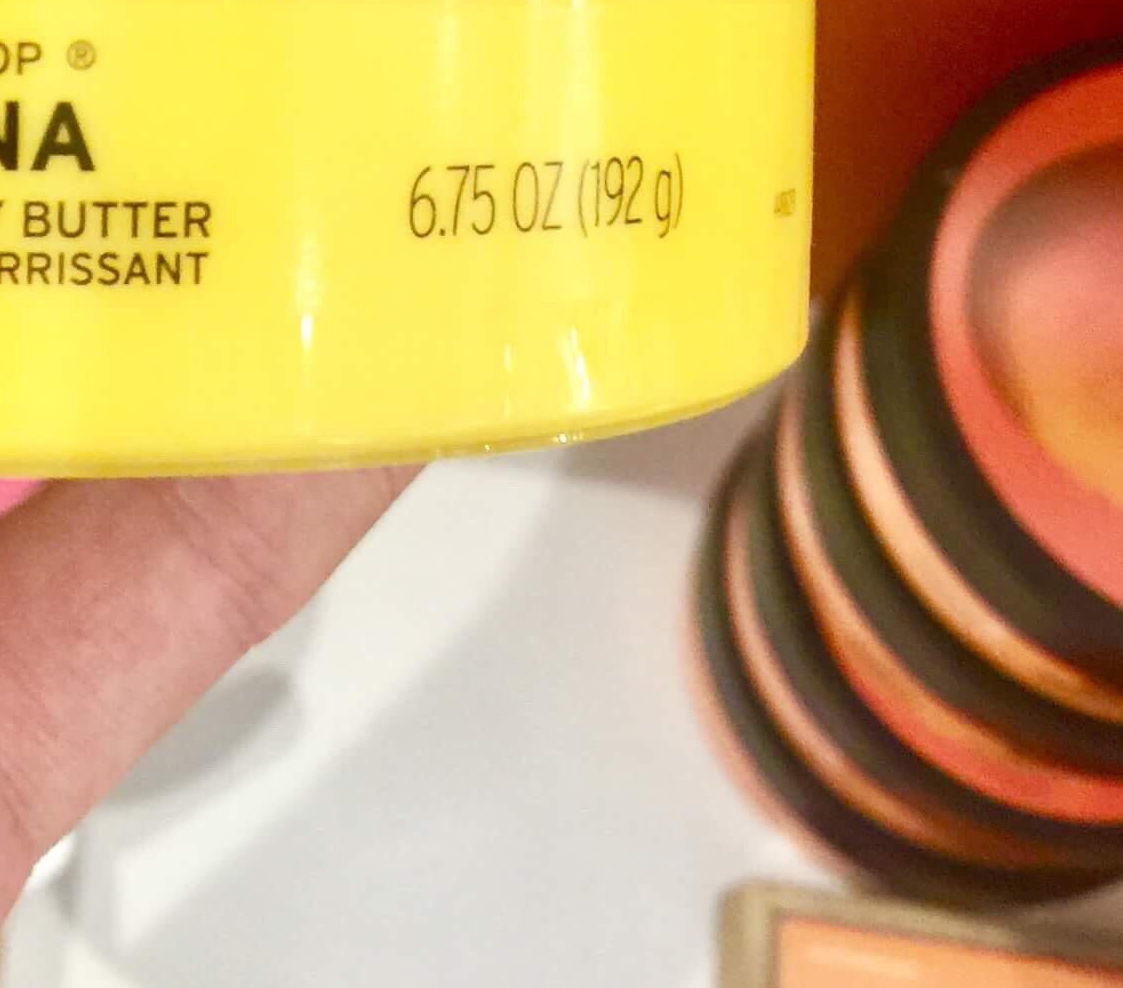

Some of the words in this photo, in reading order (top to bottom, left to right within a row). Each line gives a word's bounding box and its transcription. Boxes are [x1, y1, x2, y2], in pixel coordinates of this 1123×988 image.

[24, 200, 212, 239] BUTTER
[408, 163, 497, 239] 6.75
[512, 160, 564, 233] OZ
[577, 155, 645, 238] (192
[655, 151, 684, 239] g)
